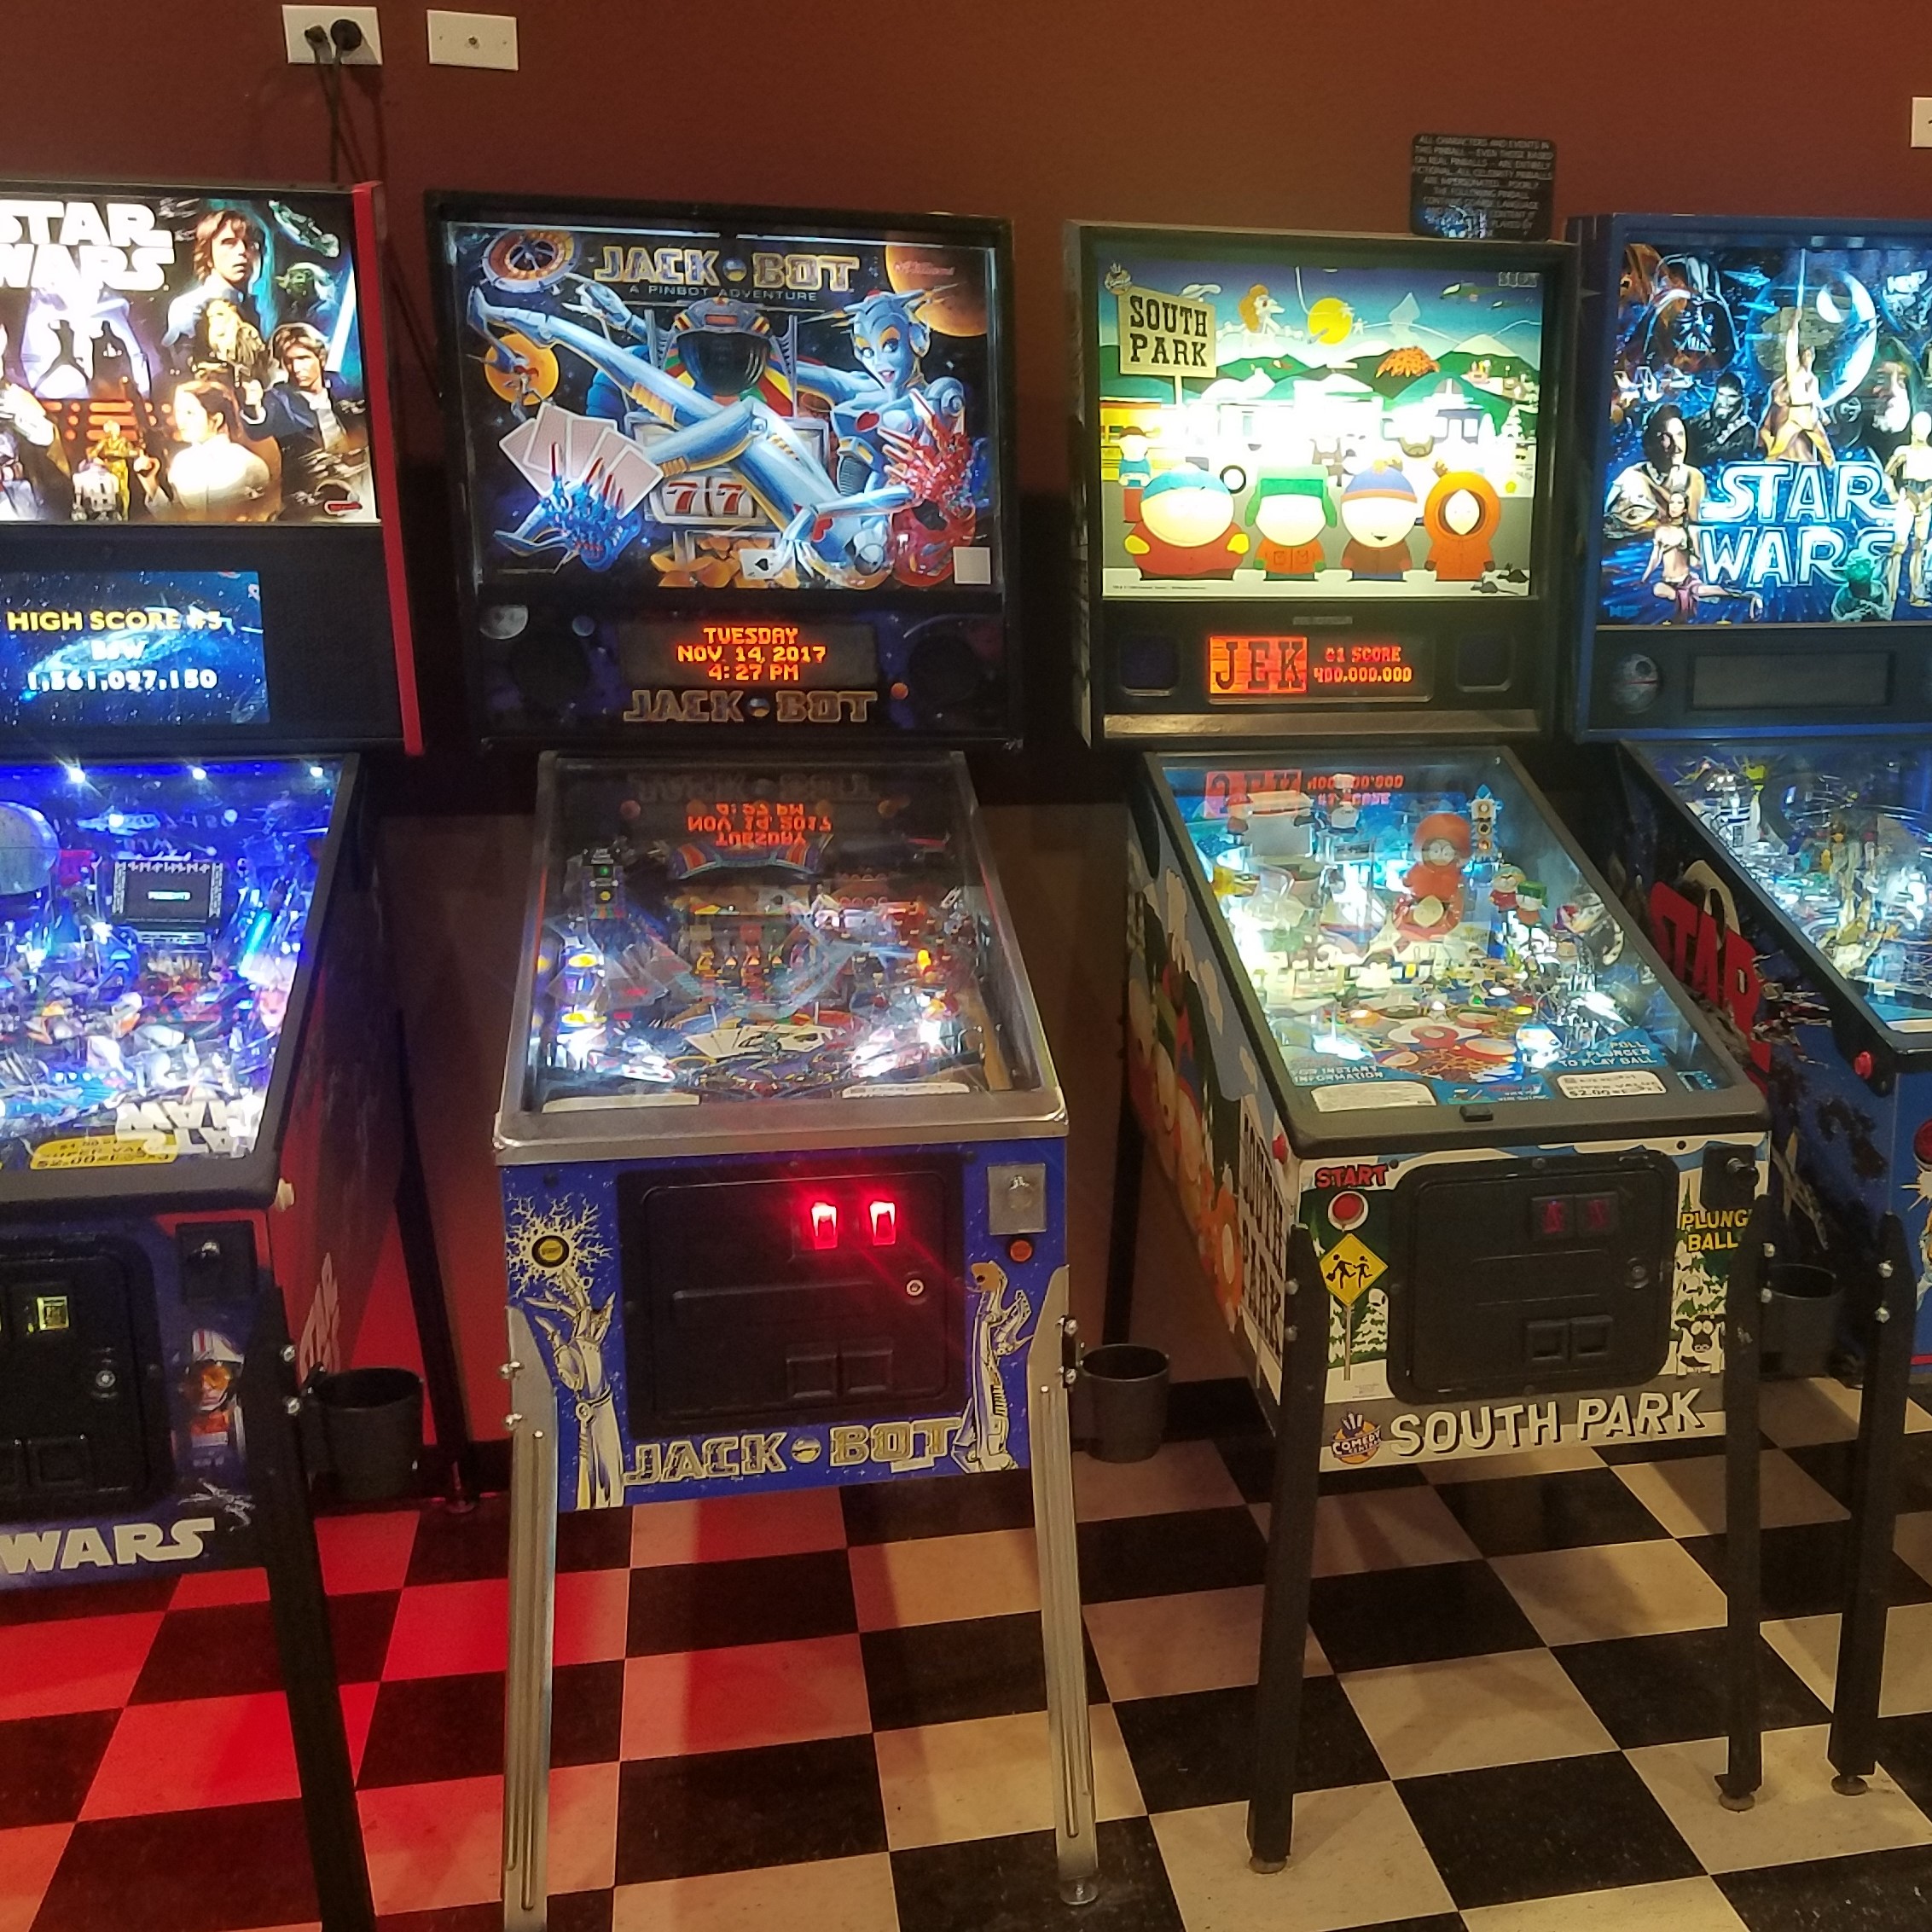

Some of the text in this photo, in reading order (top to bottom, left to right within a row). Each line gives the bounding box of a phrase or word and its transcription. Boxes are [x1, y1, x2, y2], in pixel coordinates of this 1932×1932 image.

[594, 247, 860, 292] JACK BOT
[648, 286, 708, 297] PINBOT
[719, 287, 816, 301] ADVENTURE
[1130, 295, 1207, 337] SOUTH
[1130, 334, 1207, 366] PARK
[1697, 461, 1899, 523] STAR
[8, 612, 83, 630] HIGH
[90, 611, 181, 629] SCORE
[704, 628, 798, 644] TUESDAY
[773, 646, 826, 663] 2017
[1215, 641, 1303, 690] JEK
[1351, 647, 1401, 663] SCORE
[708, 664, 799, 680] 4:27 PM
[624, 689, 878, 722] JACK BOT
[1293, 1071, 1384, 1082] INFORMATION
[1315, 1163, 1389, 1188] START
[1688, 1231, 1738, 1251] BALL
[1390, 1388, 1708, 1458] SOUTH PARK
[623, 1416, 962, 1486] JACK BOT
[1332, 1430, 1381, 1454] COMEDY
[0, 1517, 215, 1575] WARS
